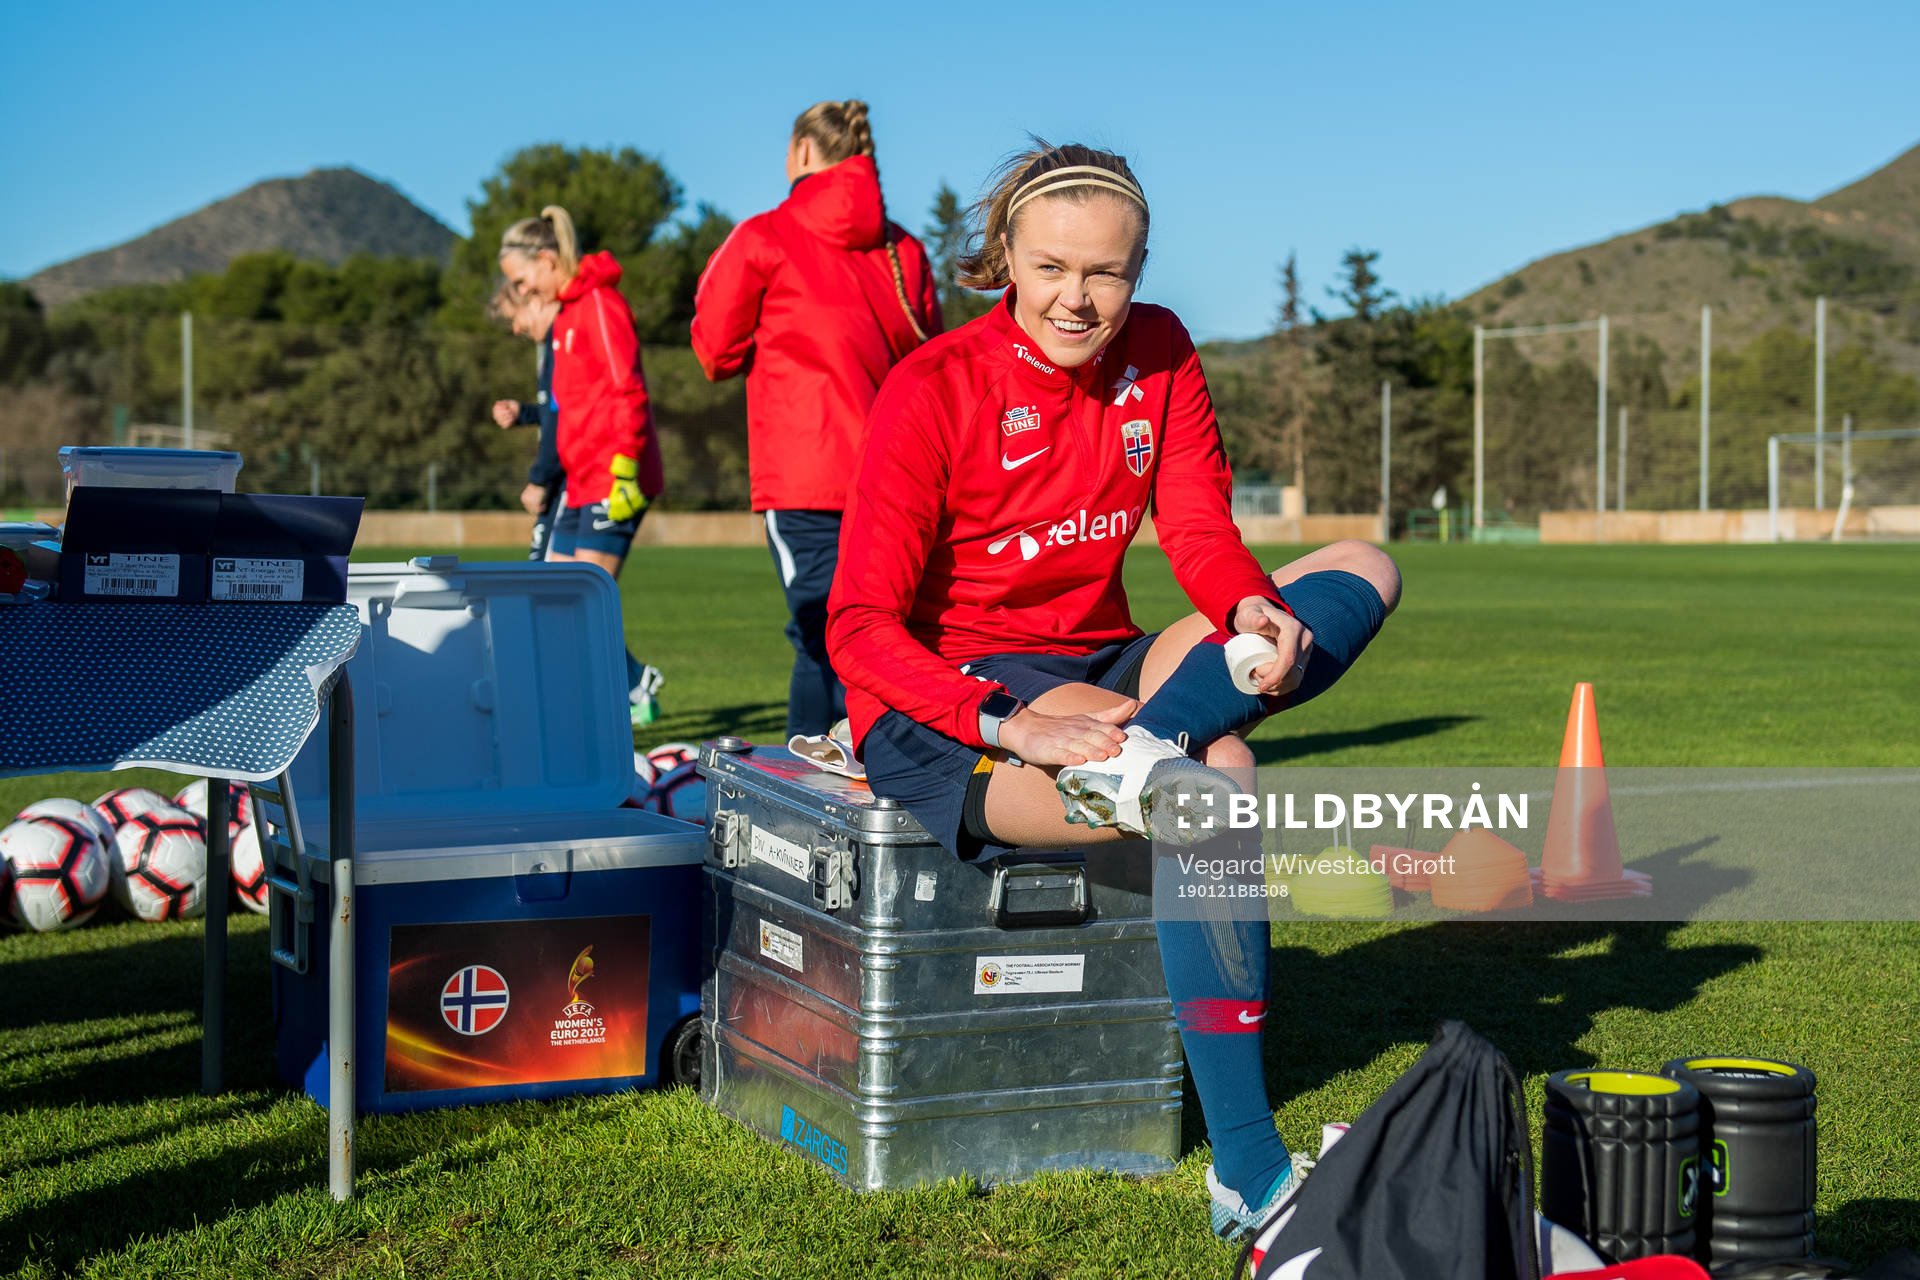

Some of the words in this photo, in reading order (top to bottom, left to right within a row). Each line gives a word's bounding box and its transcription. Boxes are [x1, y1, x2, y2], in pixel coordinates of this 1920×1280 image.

[1023, 351, 1055, 375] telenor
[1005, 417, 1036, 432] TINE
[1045, 506, 1141, 546] teleno
[90, 555, 108, 564] YT
[217, 562, 233, 570] YT
[563, 1004, 592, 1017] UEFA
[555, 1018, 603, 1030] WOMEN'S
[550, 1030, 579, 1040] EURO
[580, 1027, 606, 1038] 2017
[563, 1037, 606, 1046] NETHERLANDS
[795, 1117, 848, 1176] ZARGES
